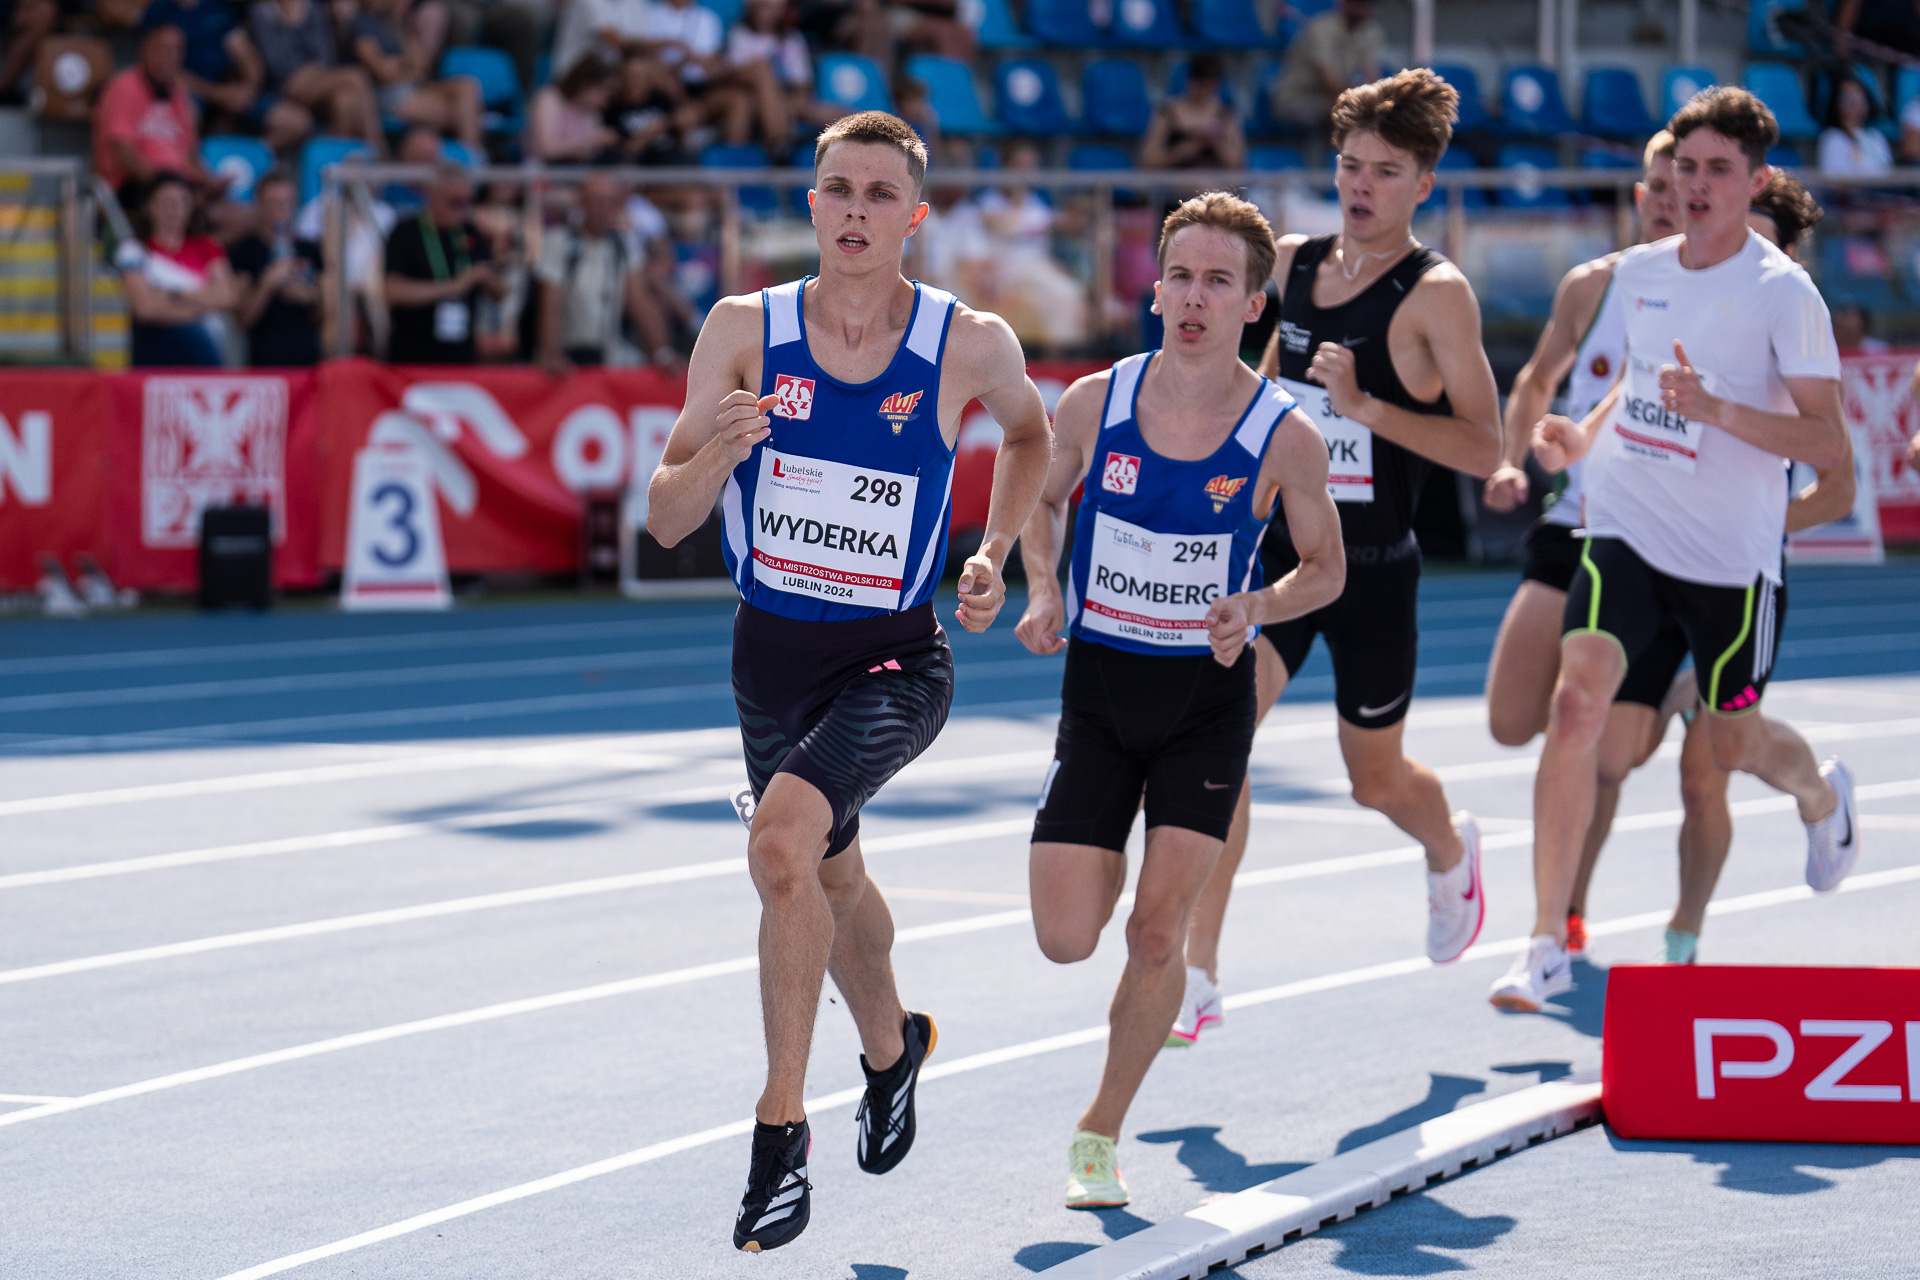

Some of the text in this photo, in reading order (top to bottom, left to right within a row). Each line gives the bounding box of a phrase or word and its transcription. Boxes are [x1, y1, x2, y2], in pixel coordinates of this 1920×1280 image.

[879, 390, 923, 413] AWF
[850, 475, 902, 507] 298
[1204, 475, 1248, 496] AWF
[369, 482, 421, 568] 3
[759, 507, 898, 559] WYDERKA
[1173, 541, 1218, 563] 294
[765, 558, 782, 569] PZLA
[783, 562, 844, 582] MISTRZOSTWA
[845, 575, 875, 585] POLSKI
[876, 579, 893, 588] U23
[1096, 564, 1219, 605] ROMBERG
[782, 576, 854, 598] LUBLIN 2024
[1117, 612, 1173, 628] MISTRZOSTWA
[1174, 621, 1201, 629] POLSKI
[1119, 623, 1183, 640] LUBLIN 2024
